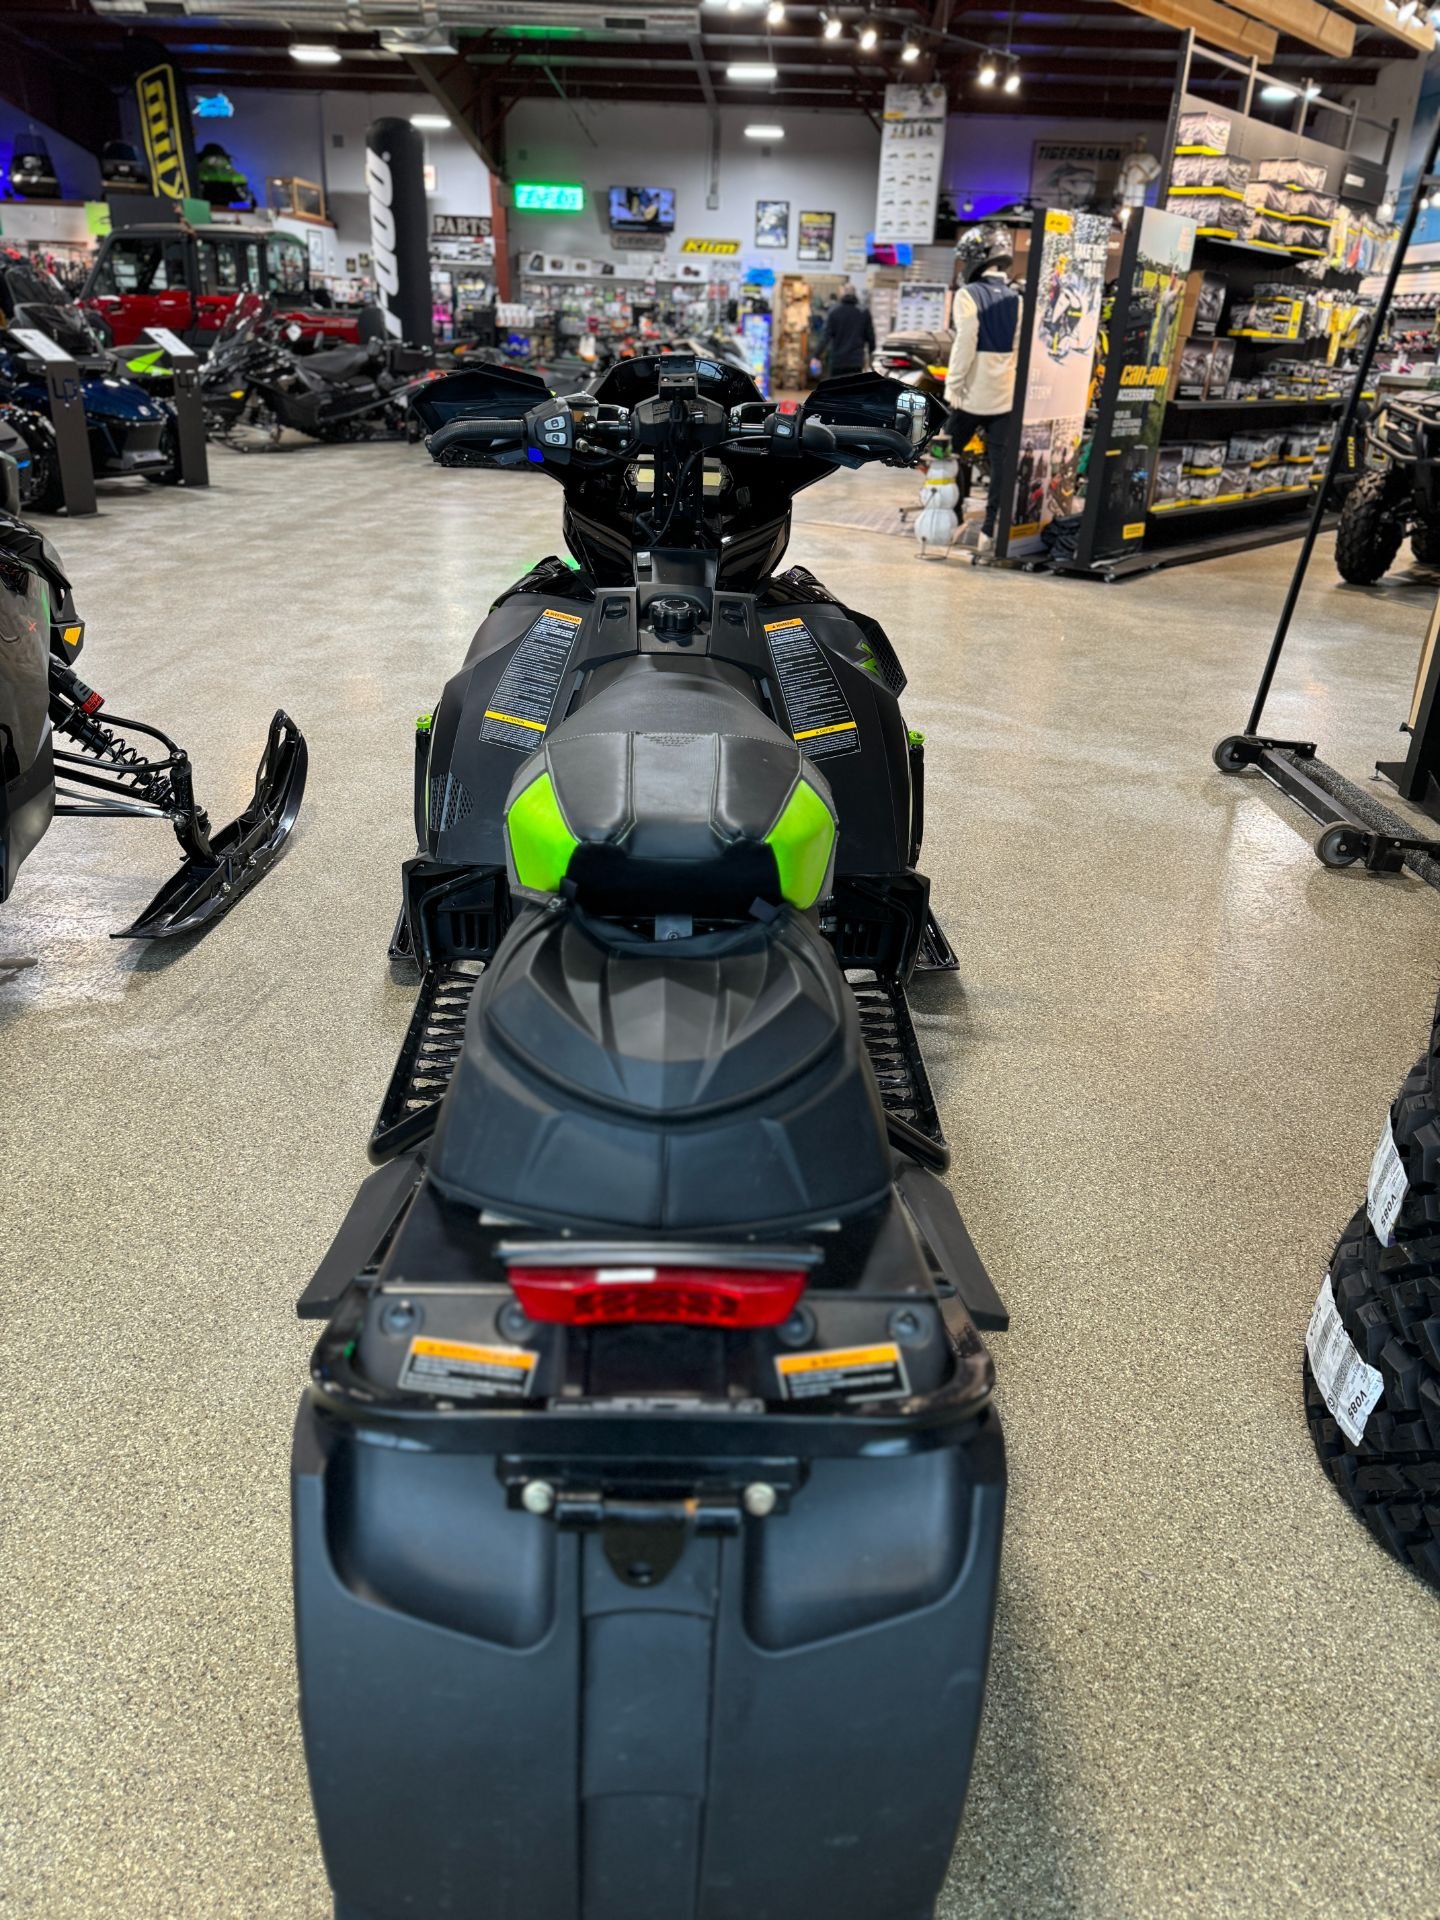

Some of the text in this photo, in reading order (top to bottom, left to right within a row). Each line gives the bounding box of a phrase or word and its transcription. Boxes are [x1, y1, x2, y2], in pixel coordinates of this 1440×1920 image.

[1038, 146, 1121, 161] TIGERSHARK
[435, 217, 491, 235] PARTS
[686, 240, 737, 254] Klim
[1380, 1194, 1397, 1228] V085
[1347, 1390, 1368, 1420] V085
